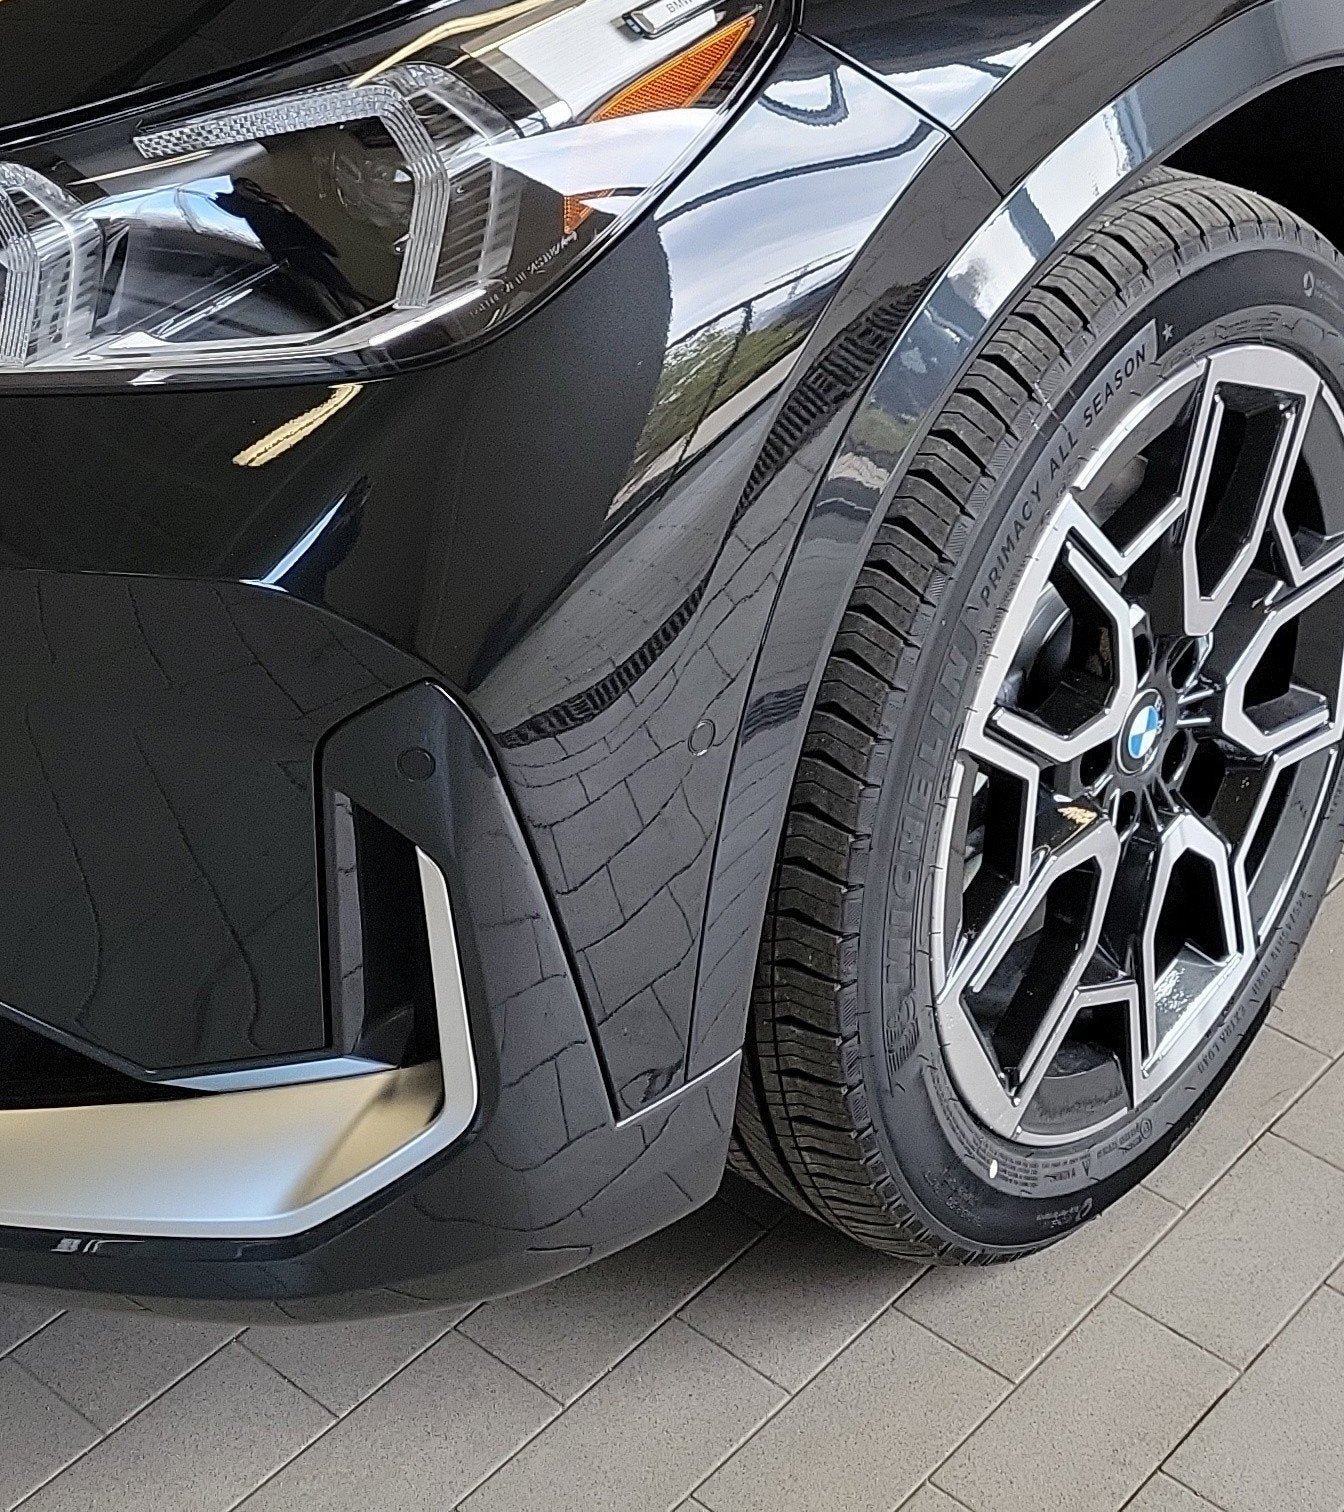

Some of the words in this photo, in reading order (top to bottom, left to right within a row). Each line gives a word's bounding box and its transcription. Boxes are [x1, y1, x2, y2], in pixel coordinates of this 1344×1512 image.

[980, 481, 1041, 608] PRIMACY
[1049, 432, 1078, 480] ALL
[1083, 343, 1147, 429] SEASON
[886, 648, 969, 985] MICHELIN
